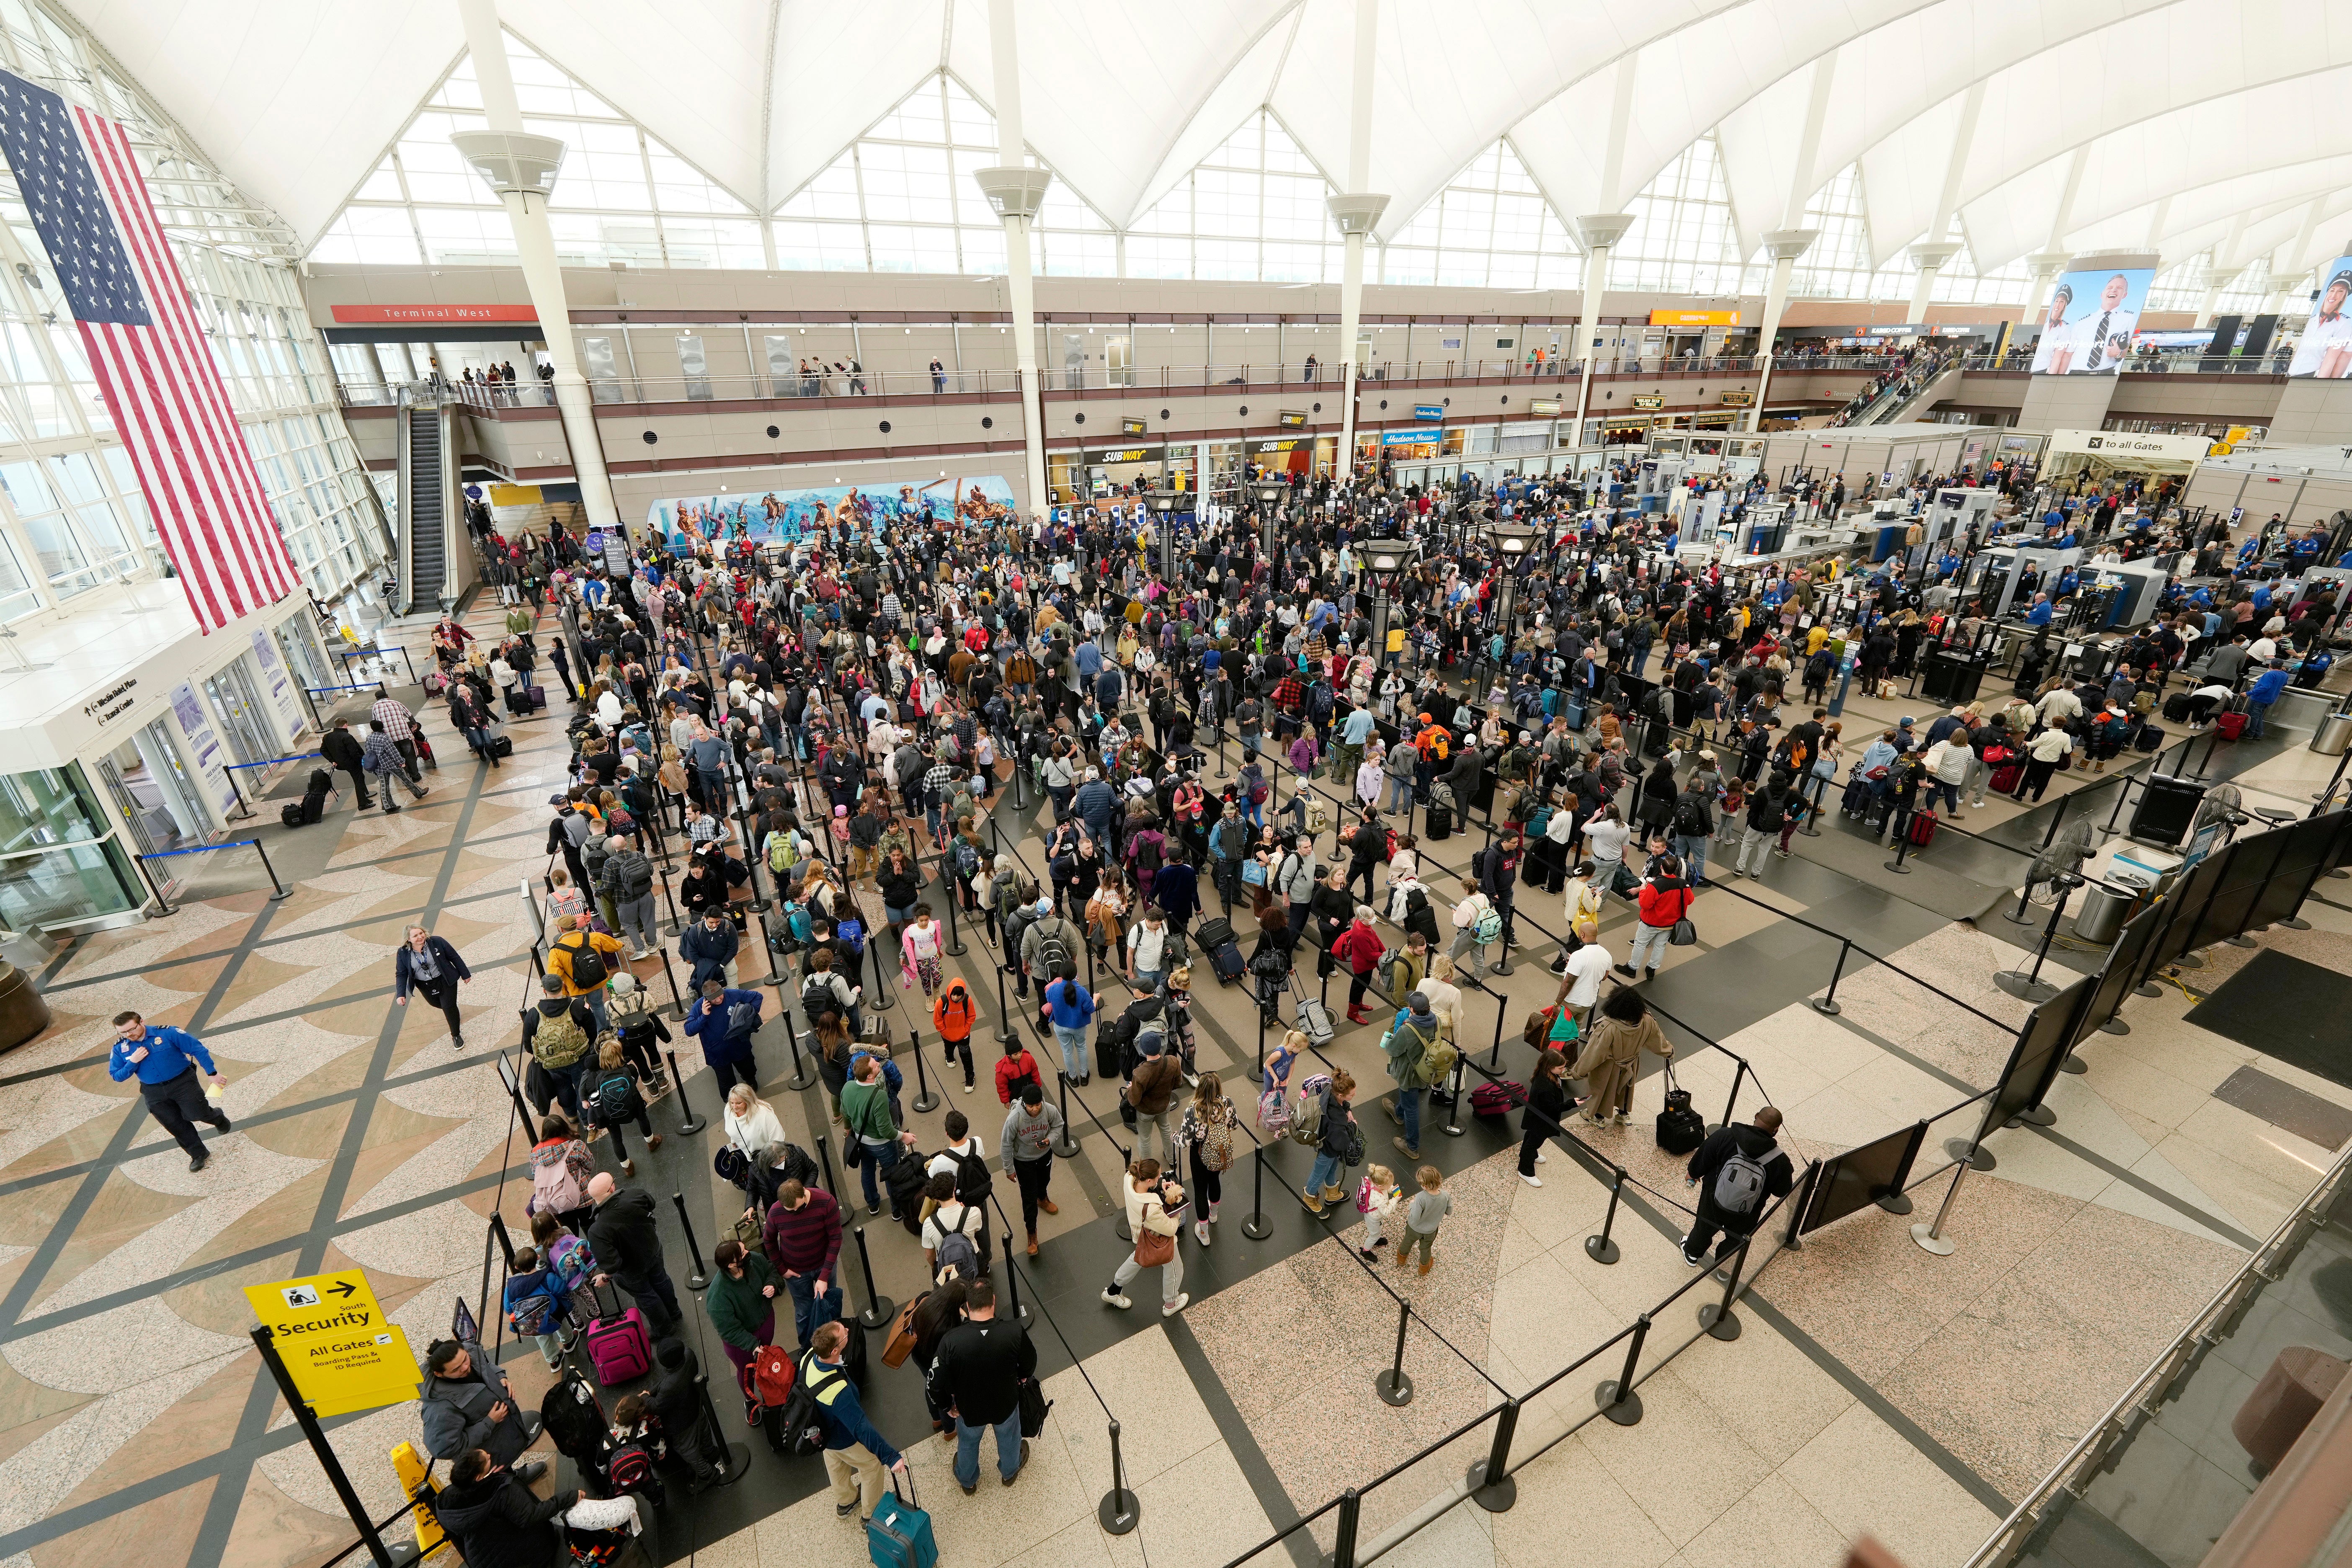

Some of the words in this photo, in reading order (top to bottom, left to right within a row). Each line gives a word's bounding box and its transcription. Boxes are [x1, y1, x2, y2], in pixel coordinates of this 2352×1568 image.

[384, 309, 449, 317] Terminal
[456, 309, 491, 317] West
[2051, 340, 2071, 351] High
[2073, 340, 2105, 348] Heart
[2321, 337, 2352, 350] High
[1282, 416, 1304, 424] SUBWAY
[1124, 423, 1142, 433] SUBWAY
[1386, 435, 1415, 444] Hudson
[1260, 440, 1298, 452] SUBWAY
[2134, 442, 2162, 451] Gates
[1102, 449, 1146, 462] SUBWAY
[97, 694, 114, 707] Westin
[124, 679, 137, 689] Plaza
[103, 707, 121, 720] Transit
[119, 698, 134, 710] Center
[175, 701, 186, 712] SKATE
[211, 761, 223, 774] SKATING!
[2194, 841, 2205, 849] HOLD
[1018, 1124, 1048, 1137] CAROLINA
[340, 1302, 366, 1311] South
[277, 1312, 369, 1336] Security
[310, 1346, 328, 1357] All
[332, 1340, 373, 1352] Gates
[314, 1357, 351, 1367] Boarding
[346, 1358, 381, 1368] Required
[409, 1480, 423, 1493] CAUTI
[423, 1517, 437, 1527] MOJ
